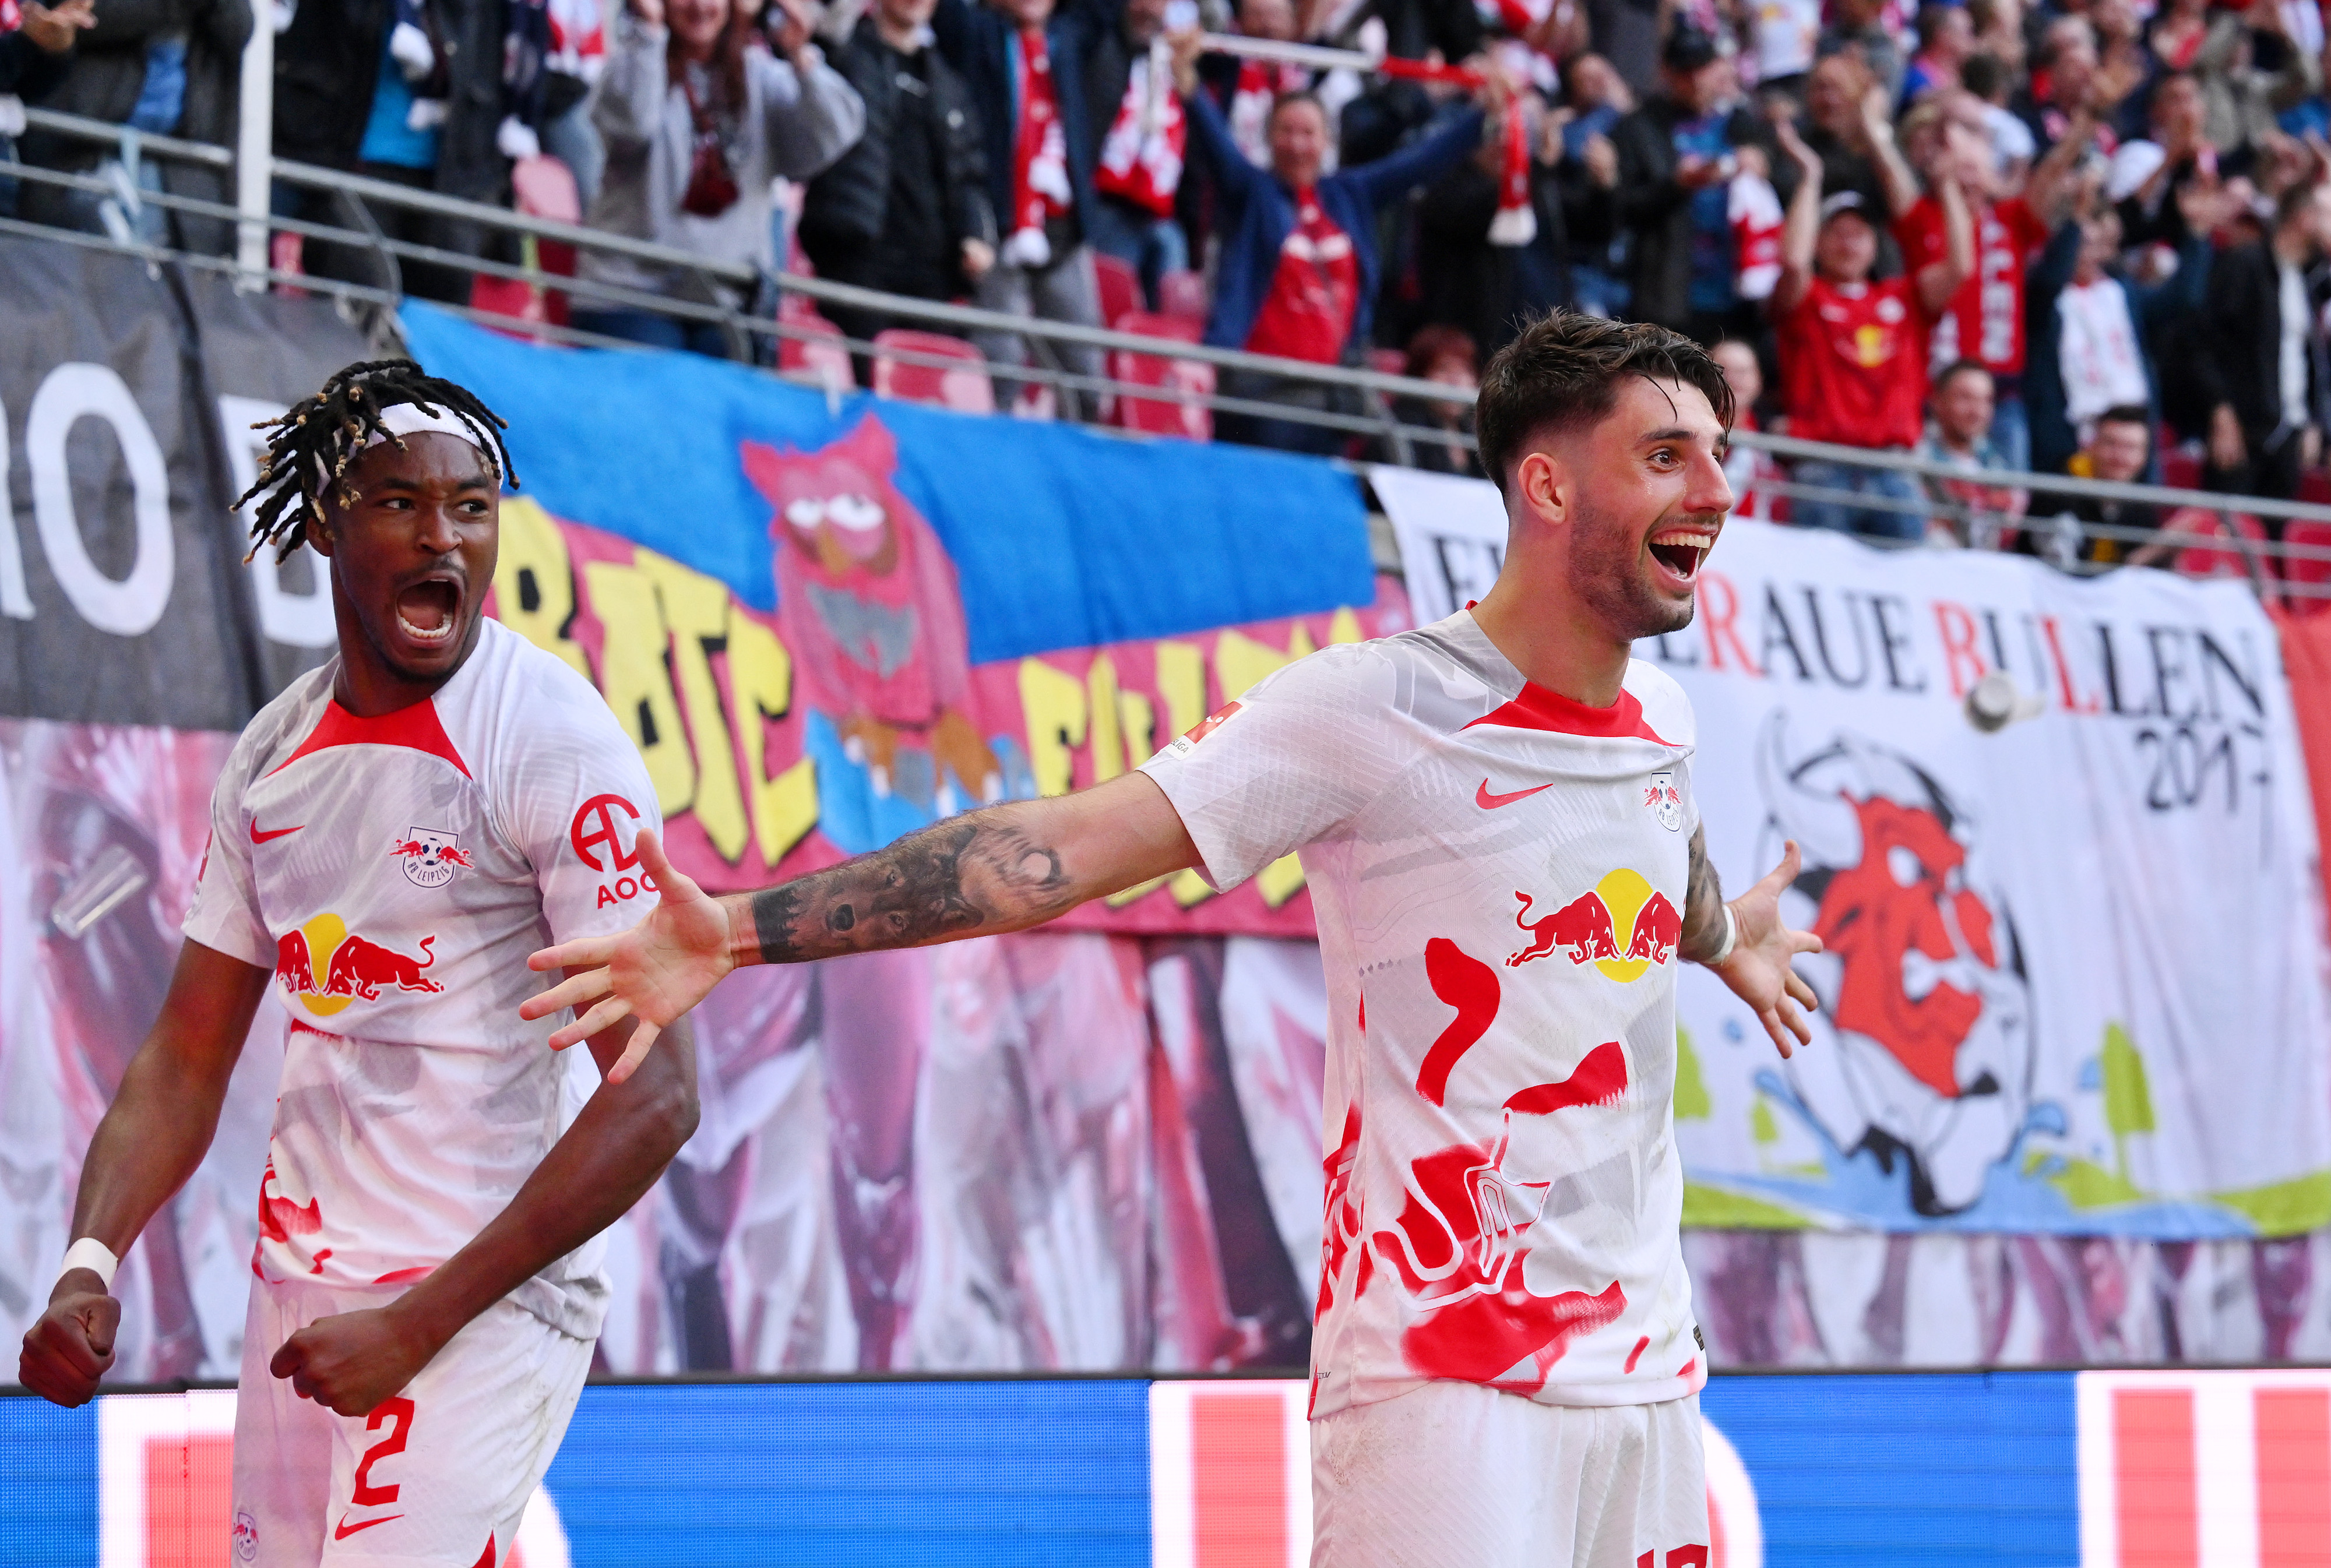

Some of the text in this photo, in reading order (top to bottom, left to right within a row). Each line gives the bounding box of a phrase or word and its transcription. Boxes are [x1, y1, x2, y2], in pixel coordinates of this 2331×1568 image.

[408, 862, 449, 882] RB LEIPZIG
[351, 1396, 415, 1507] 2
